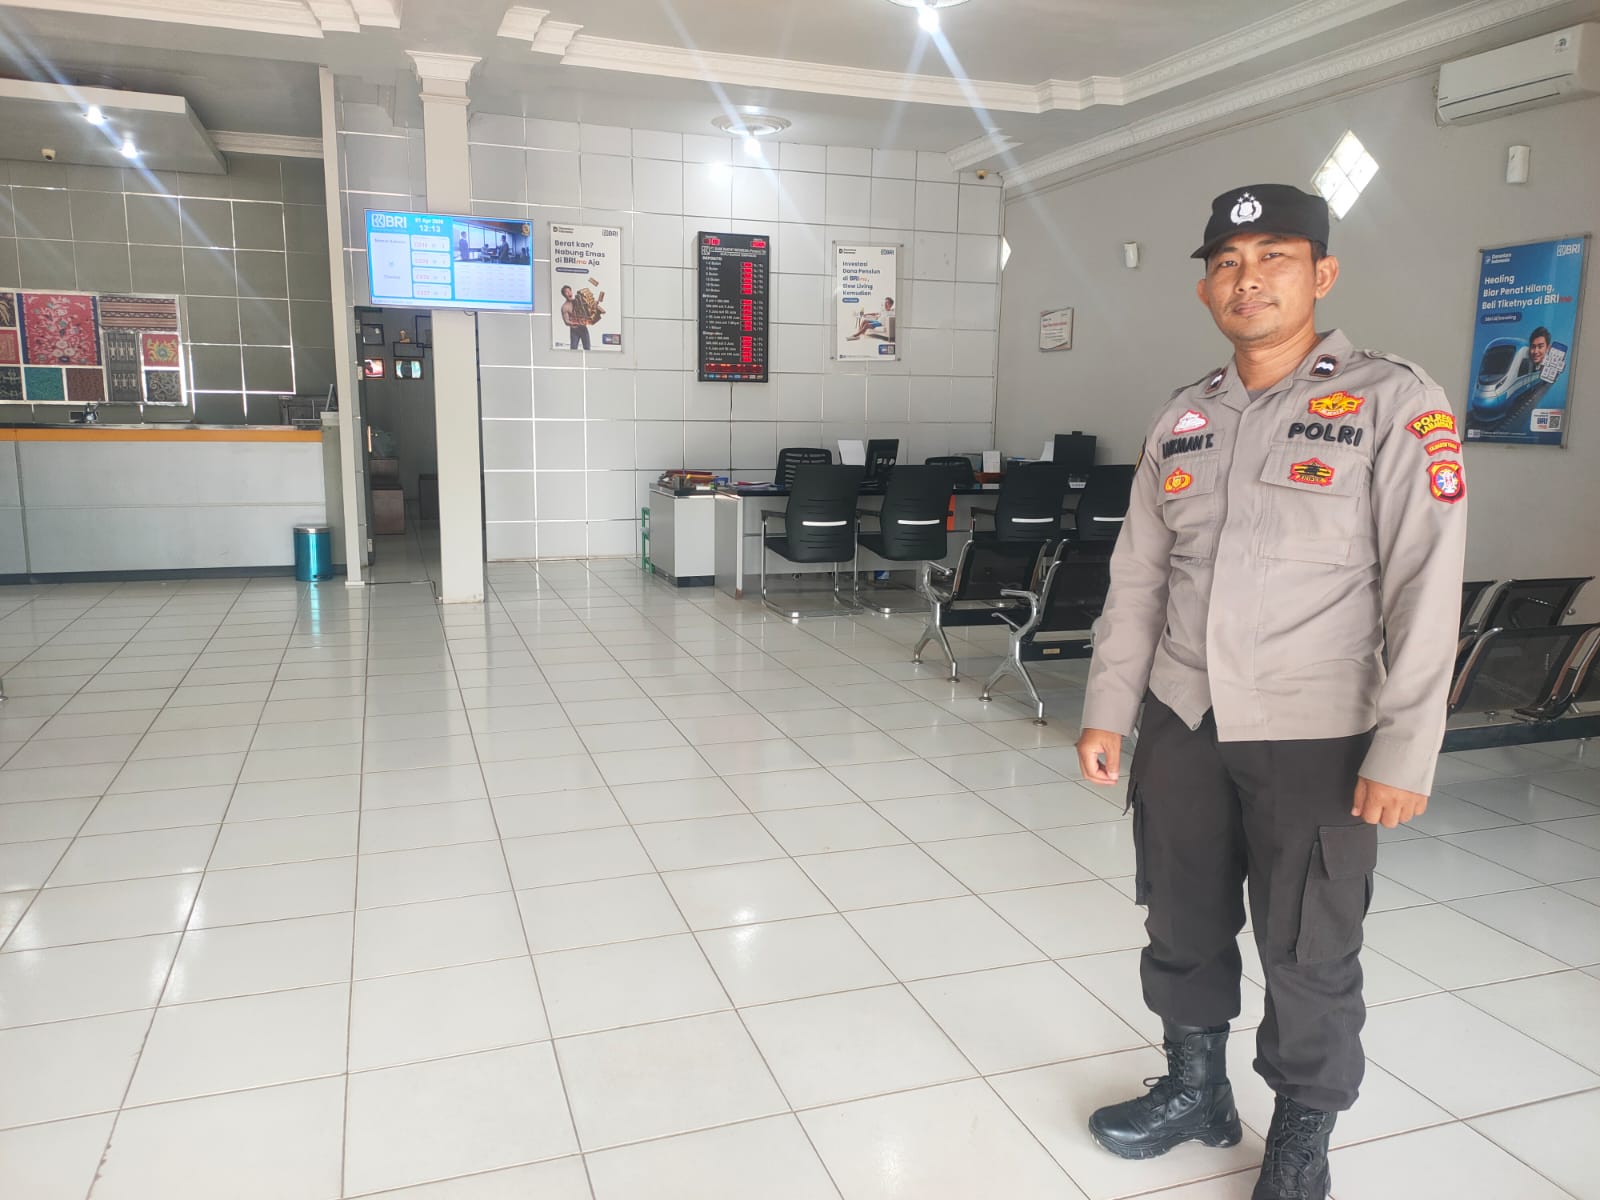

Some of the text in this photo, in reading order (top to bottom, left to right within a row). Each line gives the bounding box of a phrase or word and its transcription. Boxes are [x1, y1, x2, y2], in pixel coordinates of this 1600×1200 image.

[386, 215, 407, 228] BRI
[554, 249, 584, 258] Nabung
[1565, 243, 1580, 256] BRI
[588, 259, 600, 267] Aja
[1484, 274, 1515, 285] Healing
[1483, 283, 1555, 297] Biar Penat Hilang,
[1482, 300, 1496, 310] Beli
[1498, 298, 1533, 308] Tiketnya
[1534, 296, 1543, 305] di
[1288, 422, 1363, 447] POLRI
